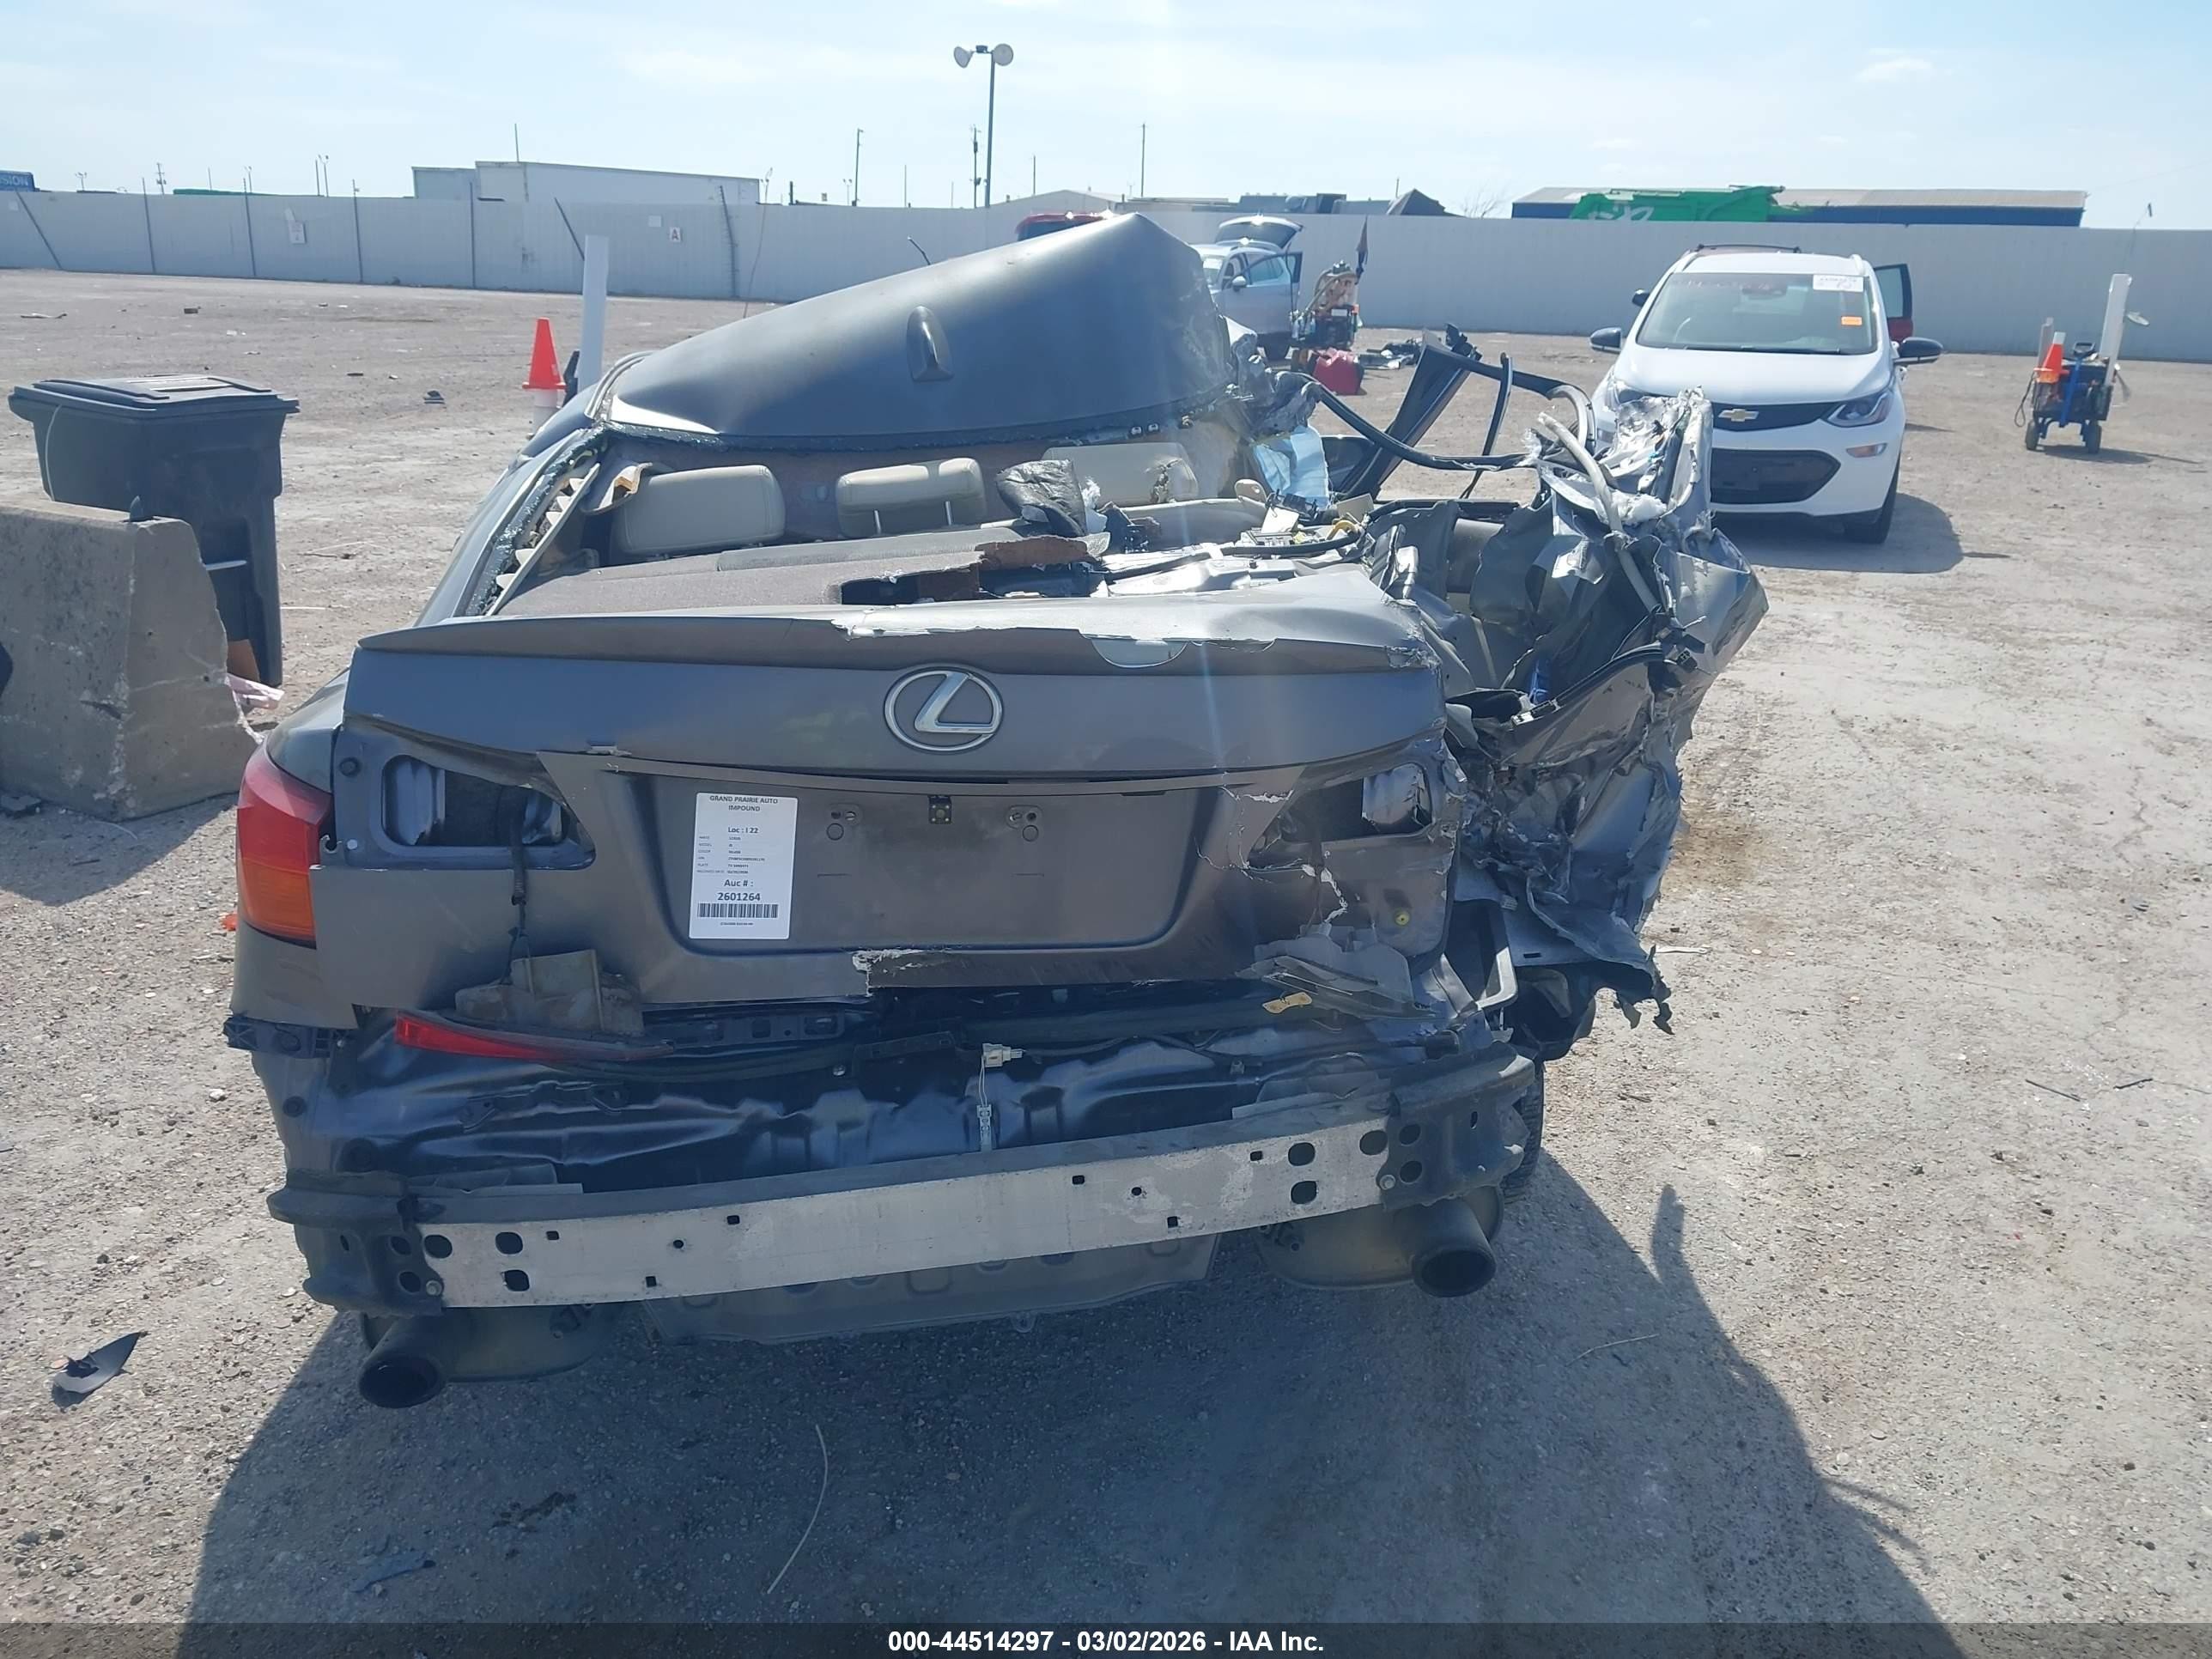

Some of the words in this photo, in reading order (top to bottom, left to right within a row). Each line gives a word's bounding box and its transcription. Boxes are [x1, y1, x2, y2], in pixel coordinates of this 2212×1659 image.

[0, 175, 28, 186] SION
[672, 228, 679, 240] A
[717, 892, 761, 902] 2601264
